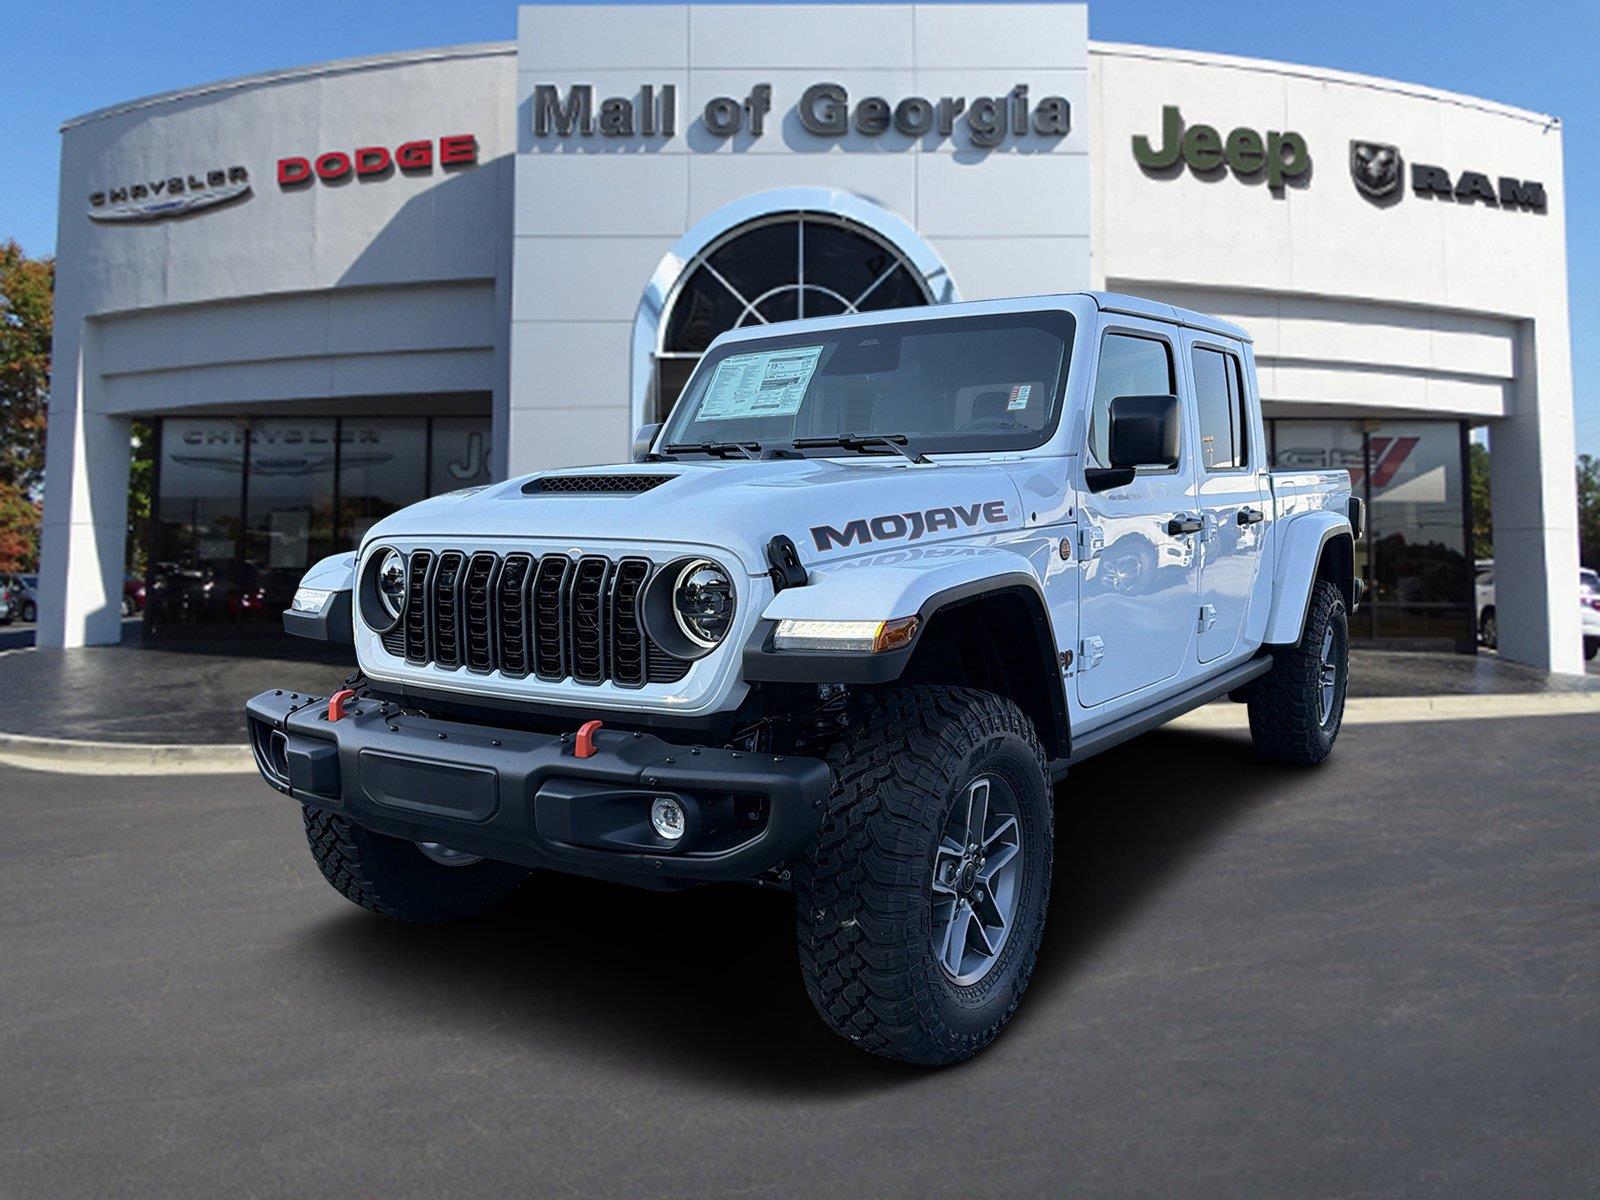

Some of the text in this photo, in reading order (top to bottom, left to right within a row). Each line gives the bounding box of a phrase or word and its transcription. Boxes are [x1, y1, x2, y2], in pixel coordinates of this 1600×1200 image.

[532, 83, 1072, 148] Mall of Georgia
[277, 133, 477, 188] DODGE
[1132, 104, 1310, 195] Jeep
[88, 165, 249, 207] CHRYSLER
[1410, 162, 1547, 213] RAM
[809, 500, 1009, 552] MOJAVE
